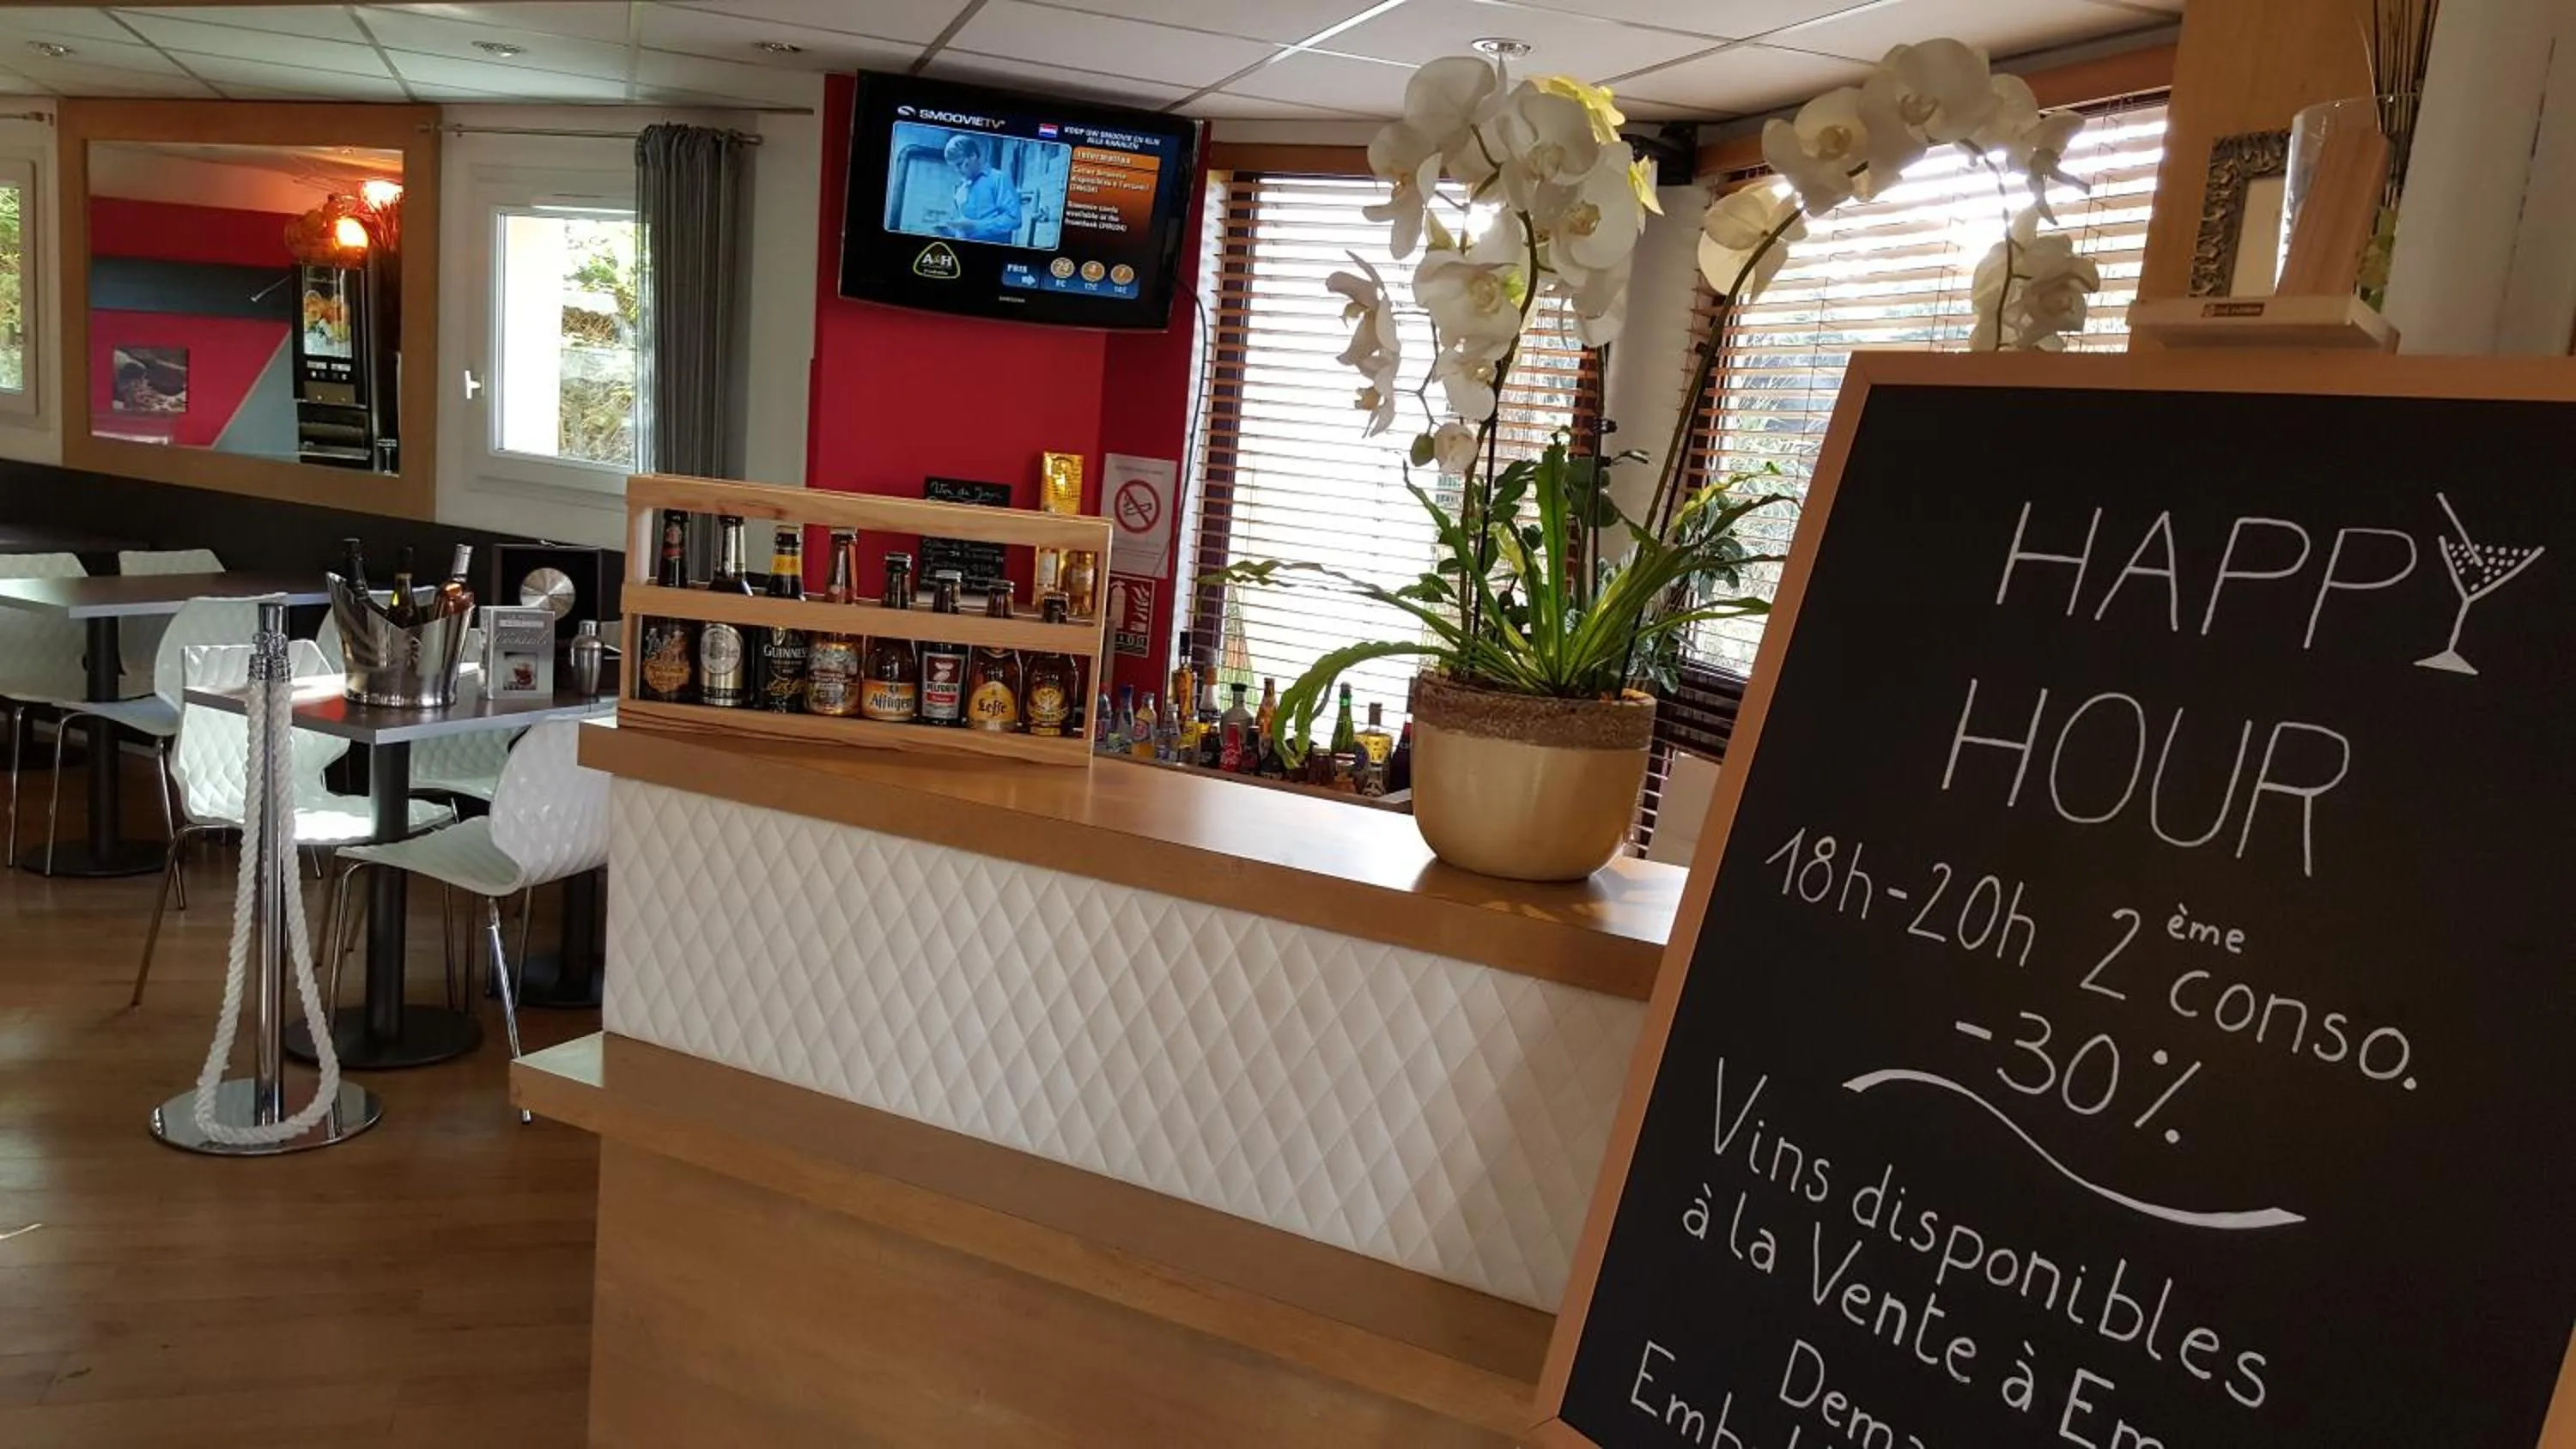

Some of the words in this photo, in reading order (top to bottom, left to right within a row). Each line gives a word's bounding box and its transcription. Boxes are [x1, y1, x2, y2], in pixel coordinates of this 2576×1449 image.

[1997, 493, 2544, 674] HAPPY
[977, 698, 1007, 717] Leffe
[1942, 679, 2349, 876] HOUR
[1766, 828, 2034, 966] 18h-20h
[2171, 971, 2416, 1089] conso.
[1684, 1182, 1710, 1239] à
[1731, 1191, 1775, 1273] la
[1814, 1222, 1975, 1380] Vente
[2002, 1341, 2035, 1411] à
[1715, 1058, 1829, 1201] Vins
[1853, 1165, 2265, 1407] disponibles
